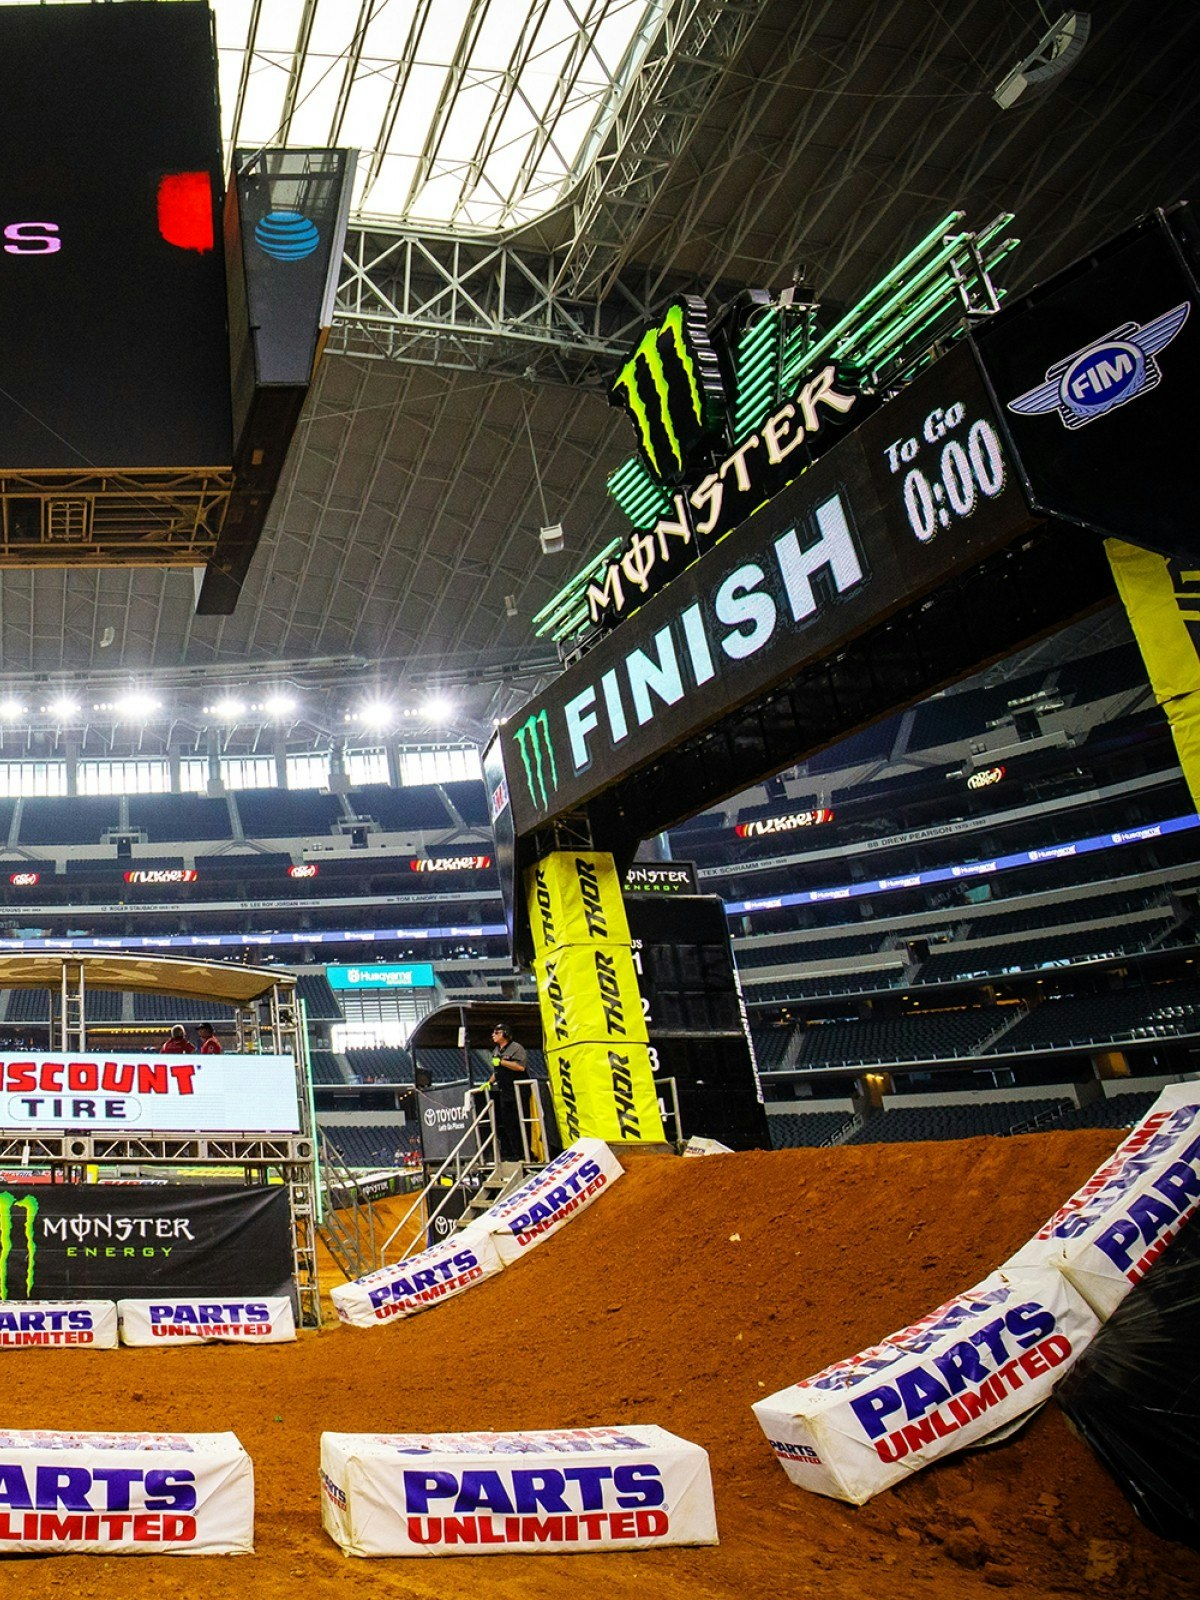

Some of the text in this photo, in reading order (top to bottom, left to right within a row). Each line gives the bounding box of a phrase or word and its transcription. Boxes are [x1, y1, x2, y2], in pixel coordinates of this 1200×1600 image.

[1071, 354, 1133, 399] FIM
[884, 402, 967, 474] To Go
[585, 366, 856, 622] MONSTER
[903, 419, 1006, 542] 0:00
[564, 493, 863, 769] FINISH
[882, 836, 907, 846] DREW
[909, 826, 952, 840] PEARSON
[624, 884, 680, 892] ENERGY
[626, 868, 690, 884] ONSTER
[720, 862, 759, 874] SCHRAMM
[535, 868, 556, 947] THOR
[575, 857, 608, 939] THOR
[632, 951, 643, 975] 1
[545, 959, 569, 1041] THOR
[595, 950, 626, 1036] THOR
[641, 998, 652, 1022] 2
[647, 1047, 660, 1072] 3
[21, 1099, 127, 1118] TIRE
[436, 1106, 468, 1122] TOYOTA
[559, 1056, 581, 1140] THOR
[607, 1050, 641, 1139] THOR
[508, 1159, 601, 1236] PARTS
[515, 1173, 608, 1247] UNLIMITED
[1094, 1134, 1200, 1273] PAR
[43, 1213, 195, 1241] MONSTER
[67, 1246, 173, 1258] ENERGY
[368, 1248, 478, 1308] PARTS
[374, 1266, 483, 1320] UNLIMITED
[149, 1304, 269, 1324] PARTS
[151, 1323, 272, 1337] UNLIMITED
[849, 1301, 1056, 1440] PARTS
[874, 1335, 1072, 1464] UNLIMITED
[769, 1440, 818, 1457] PARTS
[403, 1464, 665, 1514] PARTS
[407, 1509, 669, 1544] UNLIMITED
